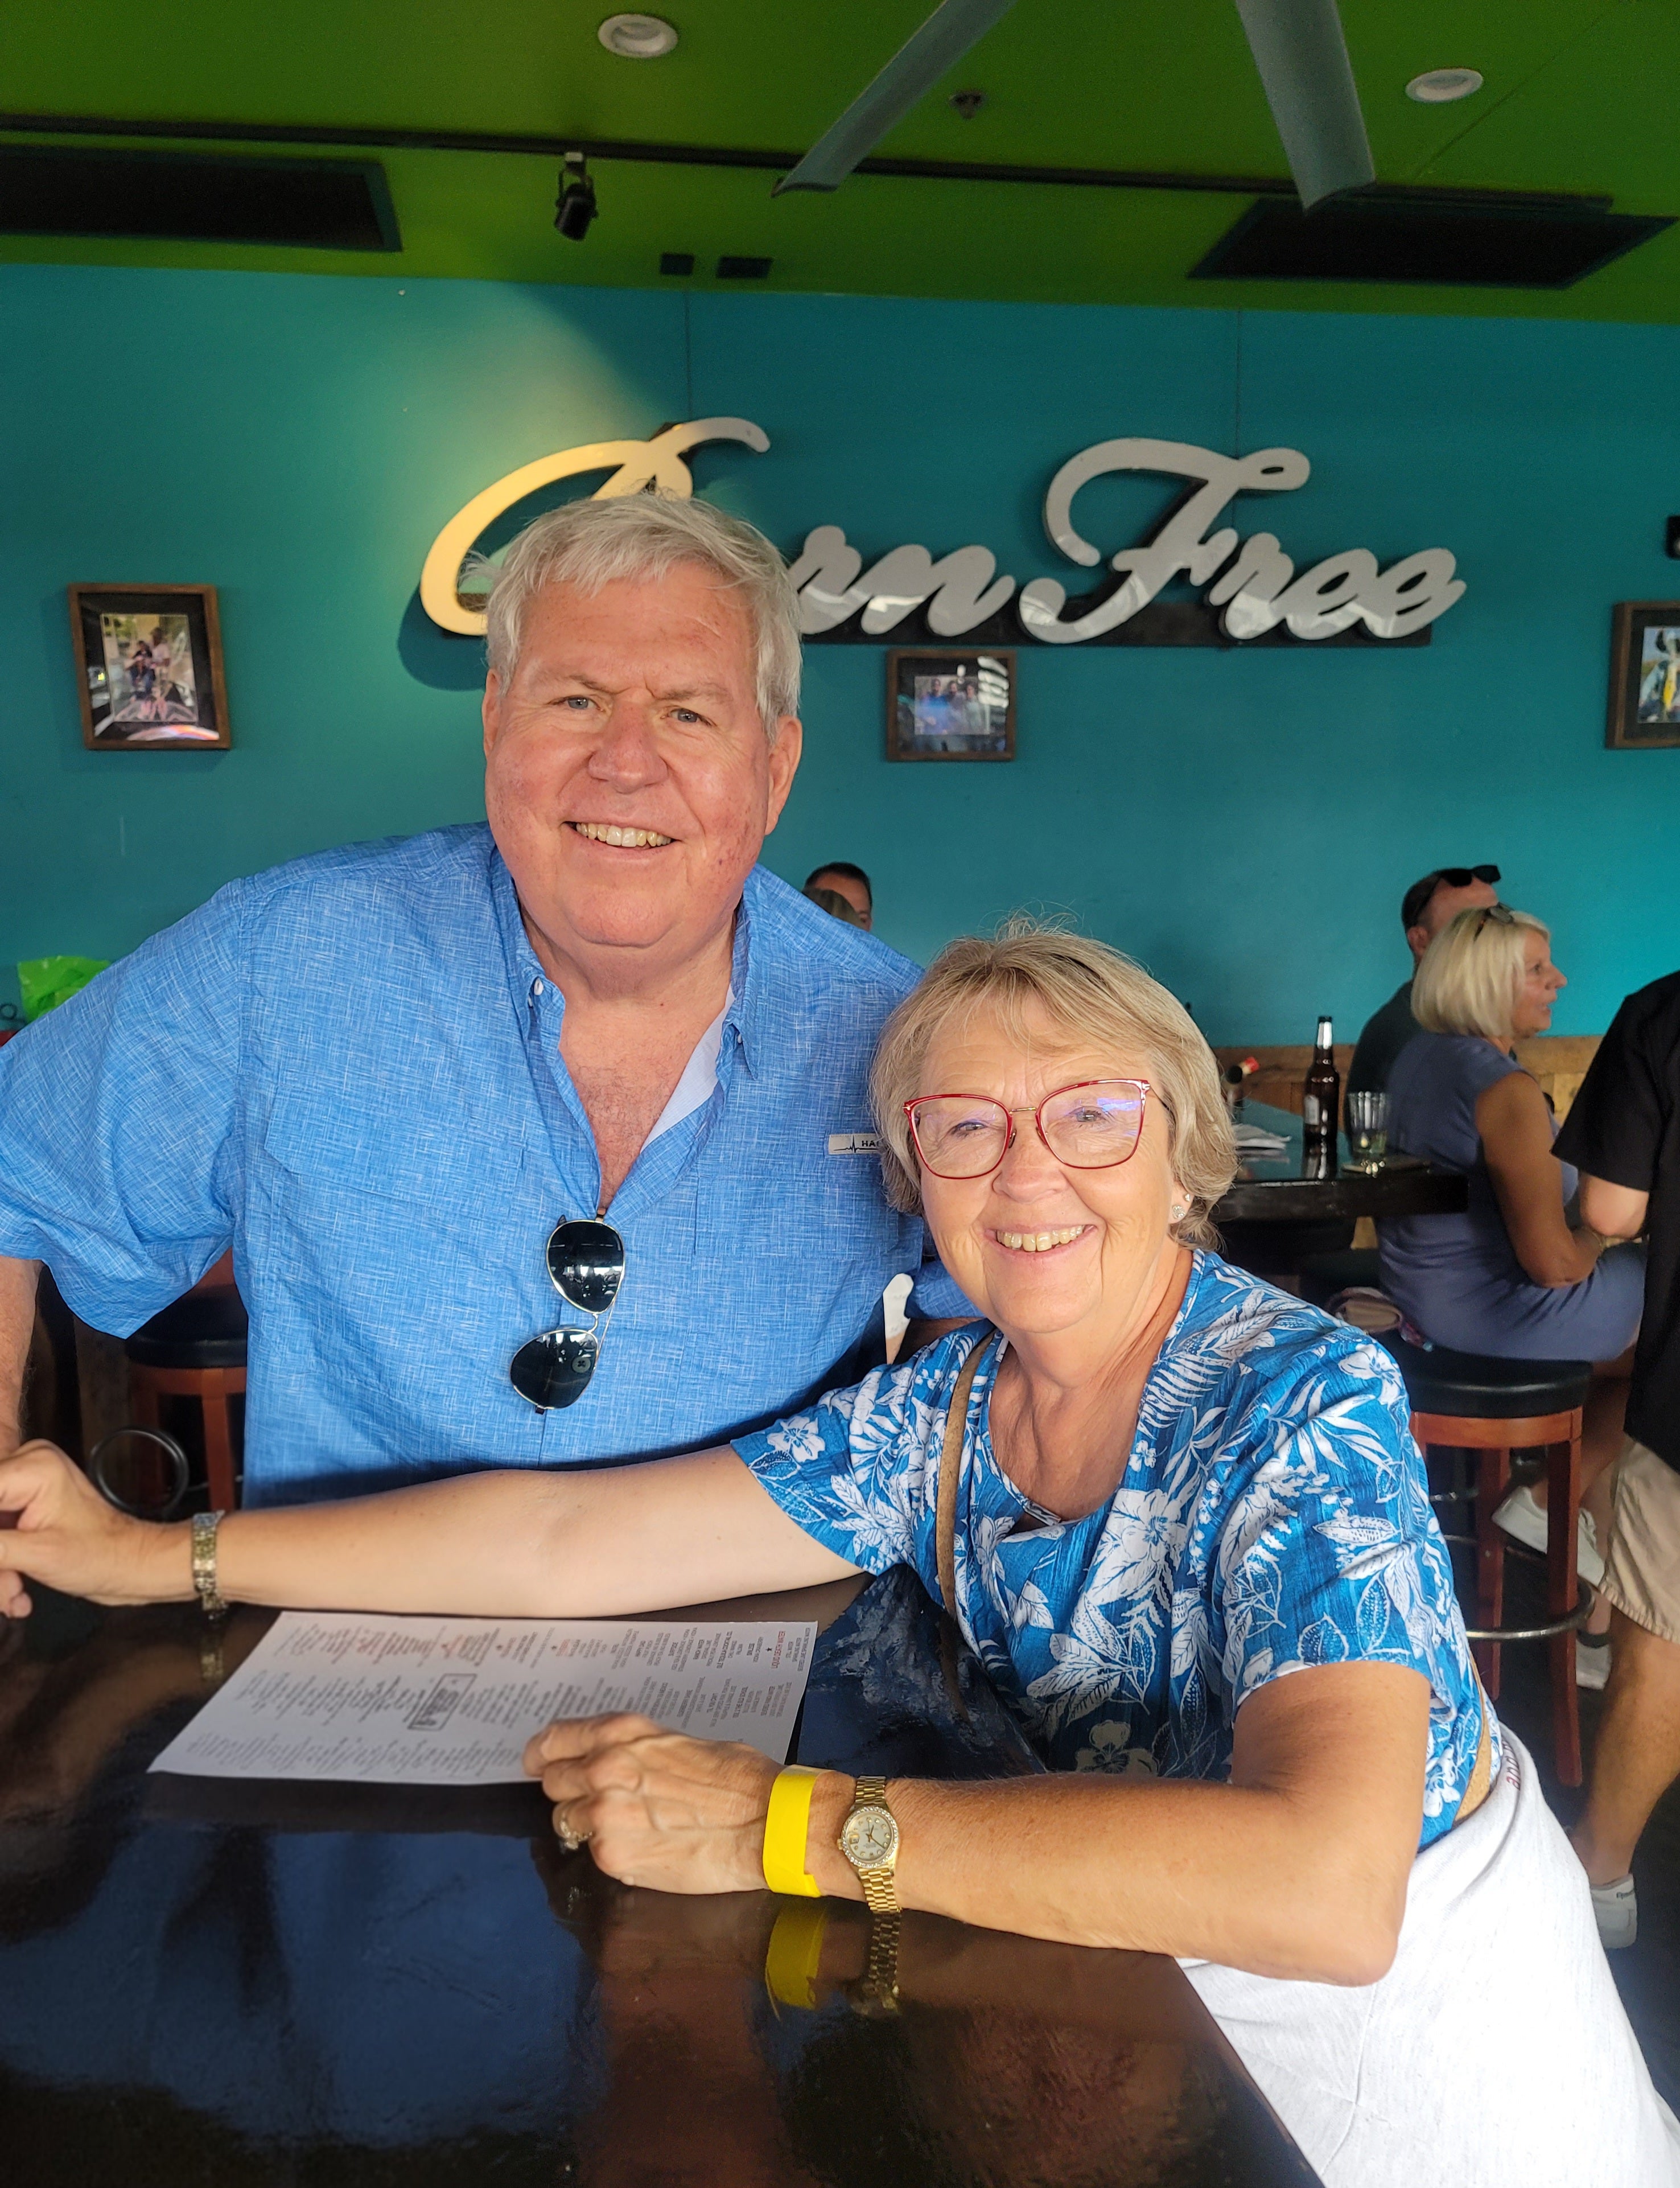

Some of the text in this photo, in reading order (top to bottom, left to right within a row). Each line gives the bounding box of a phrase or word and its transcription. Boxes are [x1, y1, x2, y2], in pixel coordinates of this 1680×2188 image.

[421, 417, 1467, 644] Brn Free
[696, 1639, 705, 1649] WATER
[769, 1630, 787, 1668] LIQUID DEATH WATER
